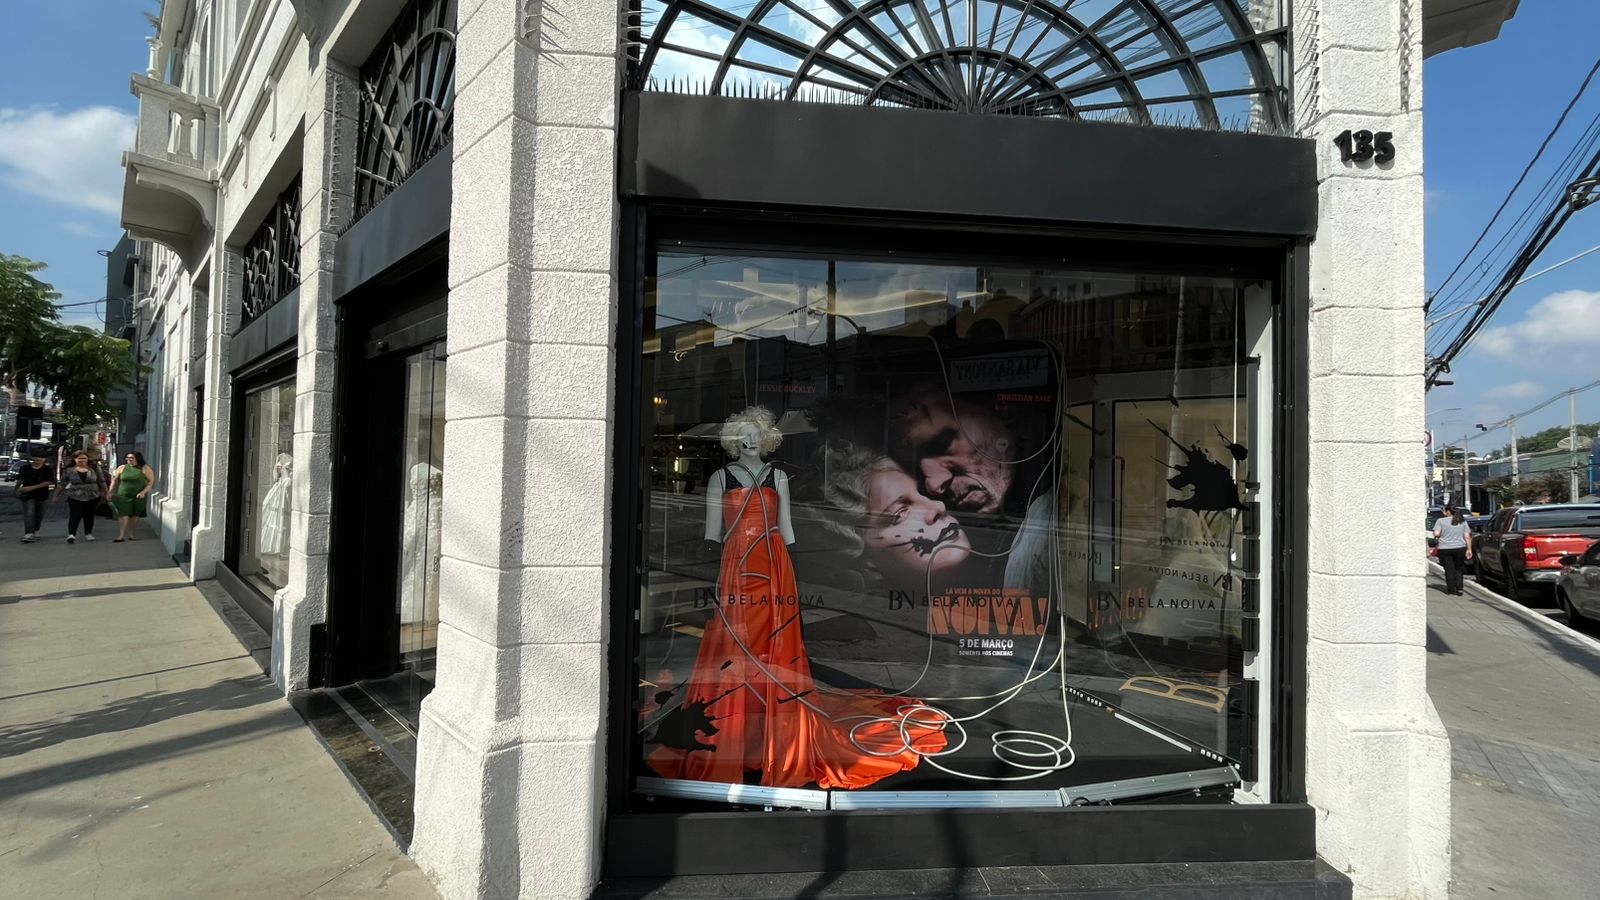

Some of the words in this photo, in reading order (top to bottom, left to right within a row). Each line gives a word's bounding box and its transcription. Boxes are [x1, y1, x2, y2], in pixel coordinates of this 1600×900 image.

[1333, 129, 1395, 164] 135
[996, 392, 1034, 401] CHRISTIAN
[728, 594, 769, 605] BELA
[889, 590, 915, 611] BN
[922, 596, 960, 608] BELA
[1128, 598, 1168, 609] BELA
[1170, 599, 1216, 610] NOIVA
[959, 638, 965, 648] 5
[967, 638, 979, 648] DE
[981, 638, 1014, 650] MARÇO
